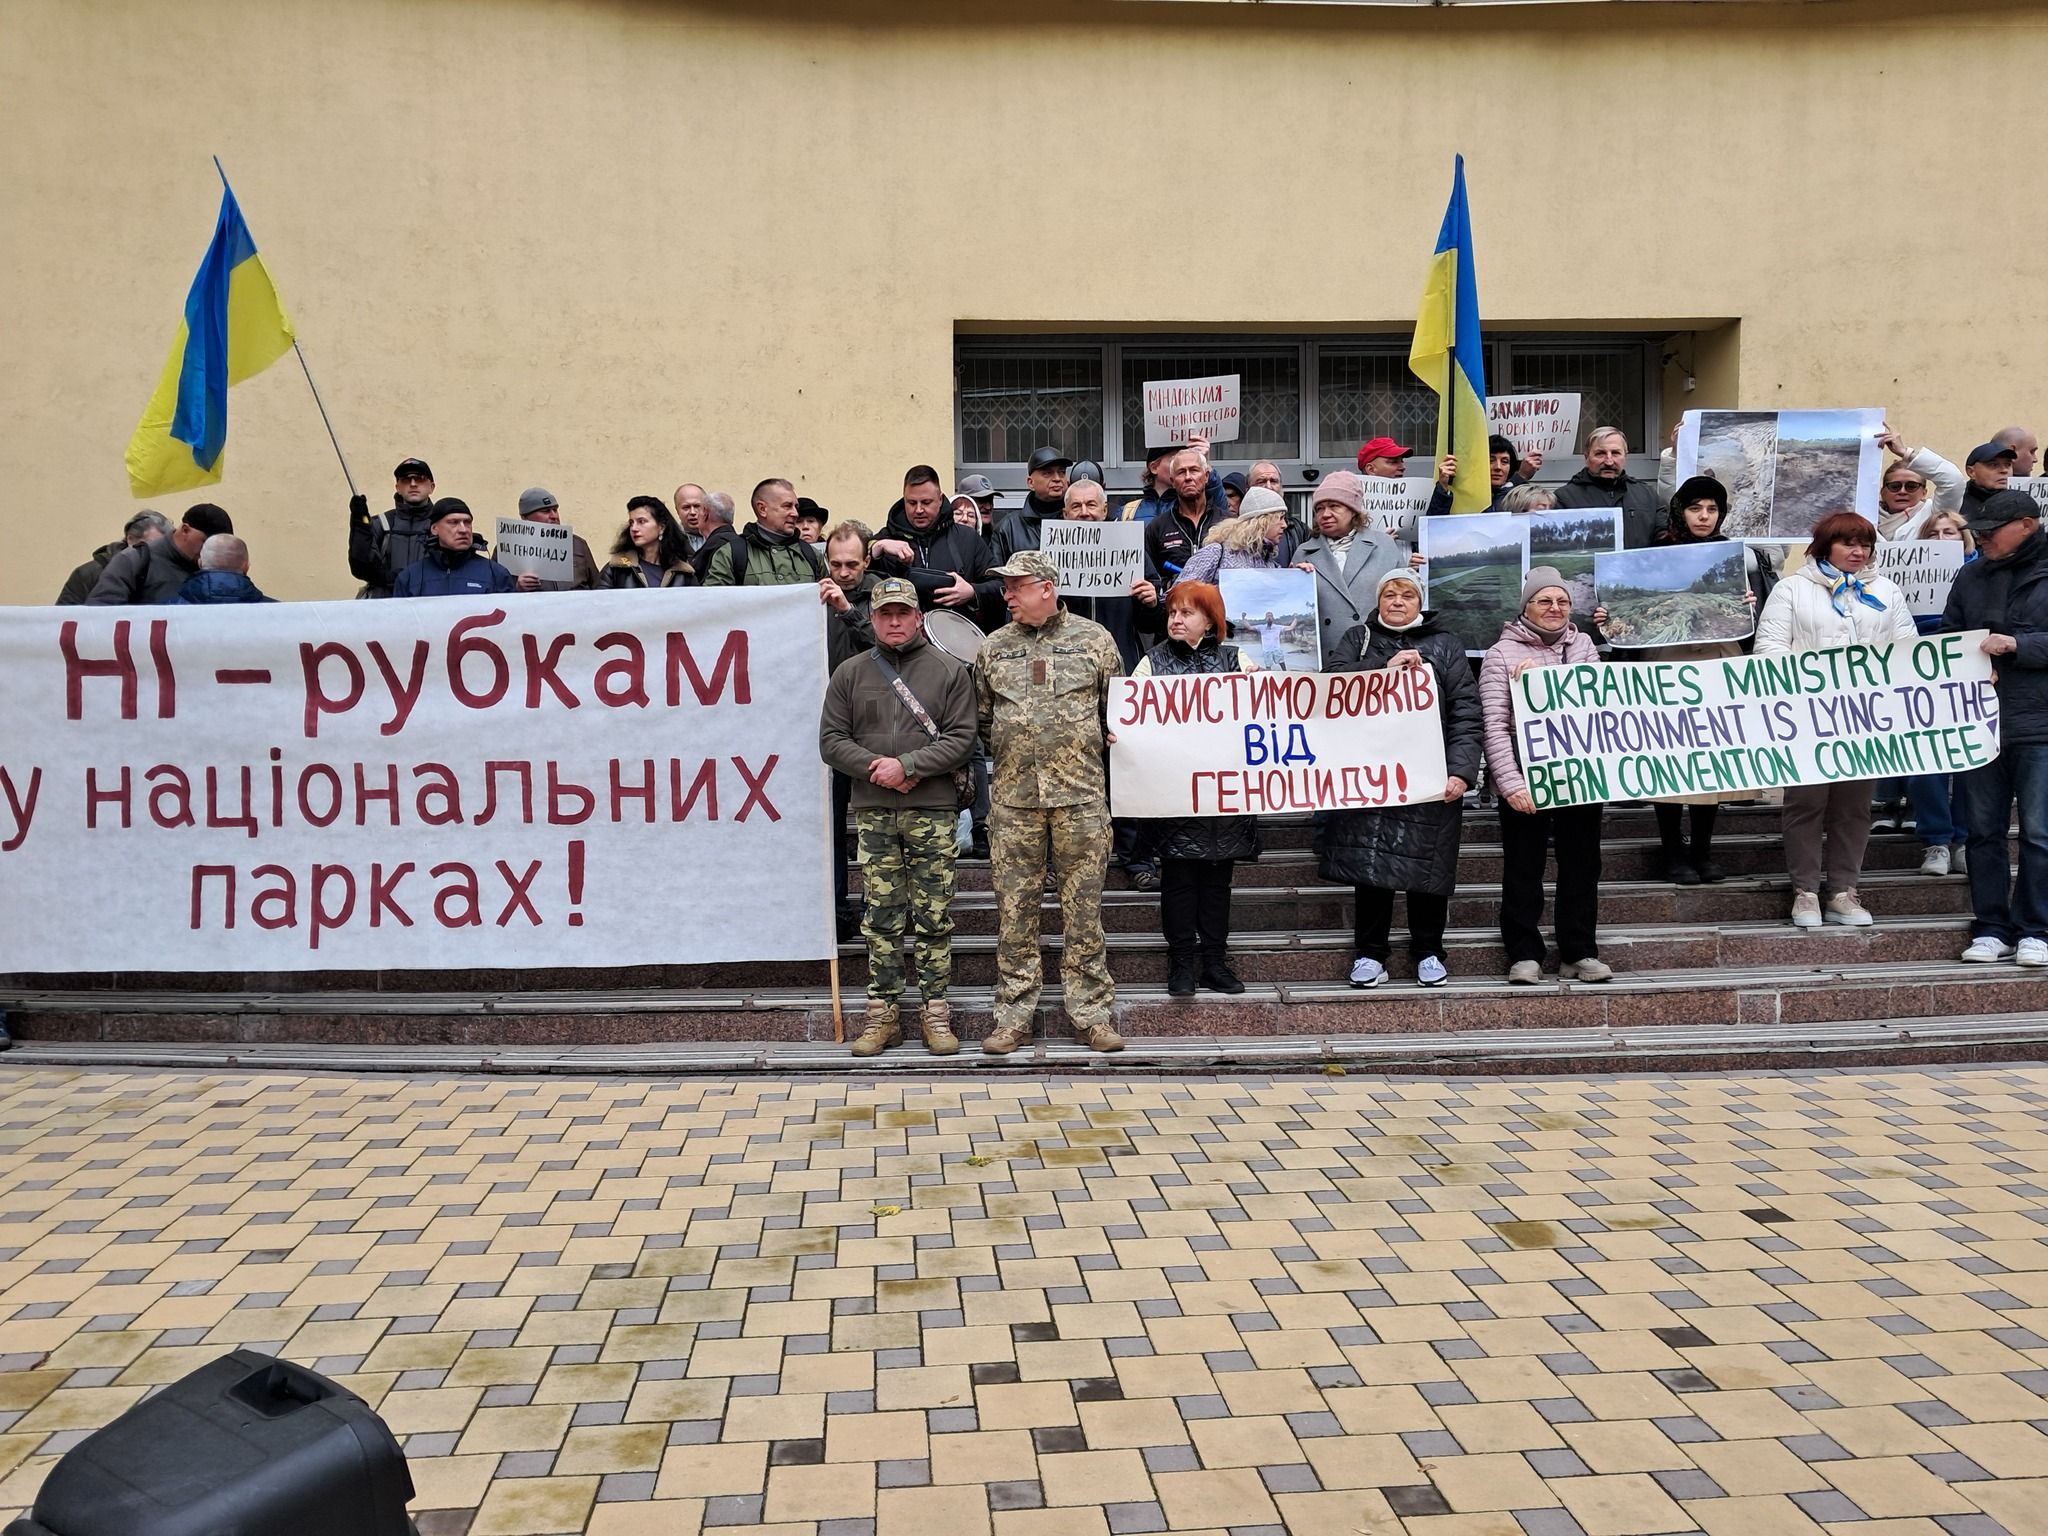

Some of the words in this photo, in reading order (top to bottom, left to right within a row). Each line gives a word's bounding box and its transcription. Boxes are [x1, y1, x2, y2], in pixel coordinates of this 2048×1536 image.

[1490, 398, 1561, 421] ЗАХИСТИМО
[1498, 421, 1545, 438] ВОВКІВ
[1551, 419, 1571, 435] ВІД
[513, 543, 567, 562] ГЕНОЦИДУ
[1046, 526, 1101, 547] ЗАХИСТИМО
[1875, 546, 1930, 568] УБКАМ
[59, 619, 177, 721] НІ
[299, 608, 753, 738] рубкам
[1120, 674, 1317, 726] ЗАХИСТИМО
[1325, 664, 1435, 720] ВОВКІВ
[1522, 664, 1704, 714] UKRAINES
[1722, 642, 1895, 700] MINISTRY
[1912, 635, 1963, 681] OF
[1244, 722, 1317, 767] ВІД
[1523, 704, 1747, 763] ENVIRONMENT
[1761, 701, 1798, 742] IS
[1808, 692, 1894, 738] LYING
[1893, 686, 1935, 730] TO
[1940, 680, 1999, 723] THE
[0, 766, 42, 852] у
[86, 747, 783, 838] національних
[1191, 762, 1408, 814] ГЕНОЦИДУ!
[1527, 757, 1611, 811] BERN
[1618, 745, 1802, 799] CONVENTION
[190, 840, 586, 950] парках!
